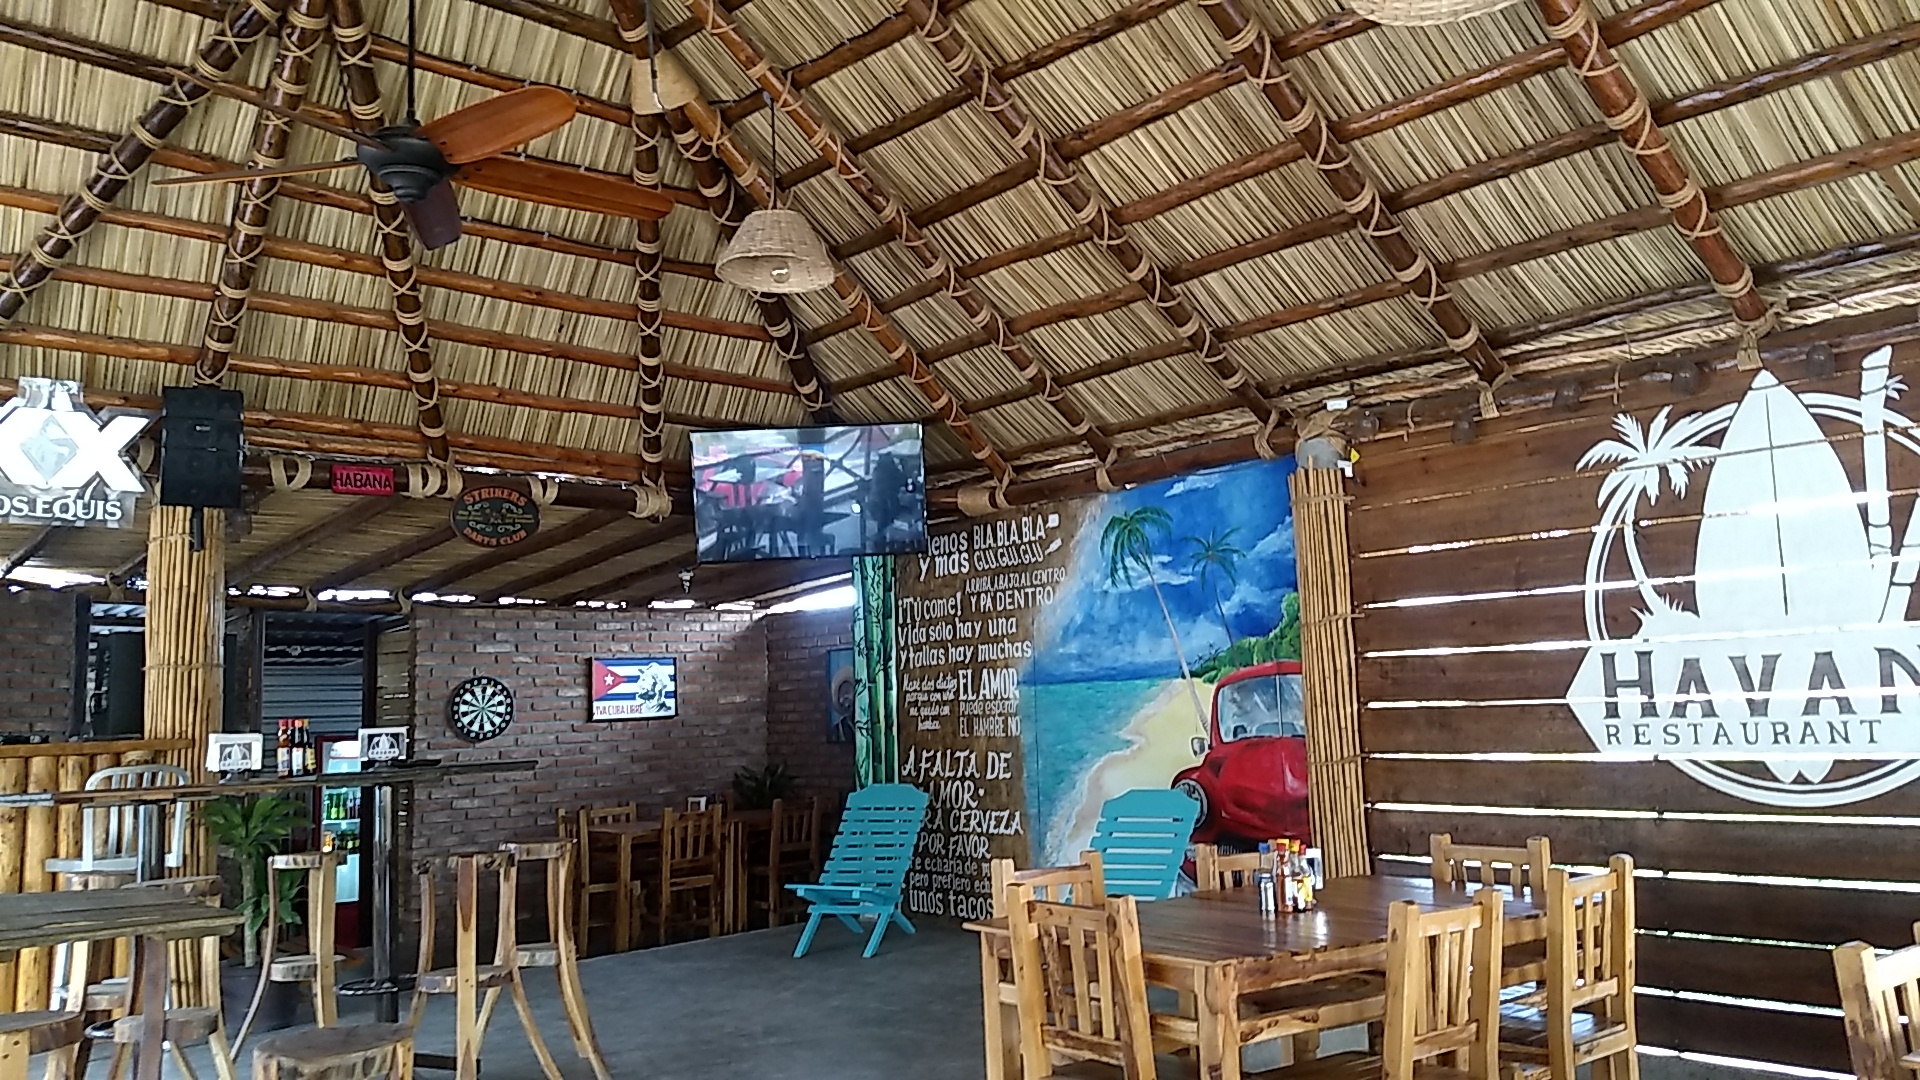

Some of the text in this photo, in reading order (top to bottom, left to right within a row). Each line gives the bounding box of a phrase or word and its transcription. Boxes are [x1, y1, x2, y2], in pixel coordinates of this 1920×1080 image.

[333, 472, 392, 490] HABANA
[463, 487, 527, 506] STRIKERS
[36, 497, 122, 520] EQUIS
[463, 527, 527, 546] DARTS CLUB
[1032, 567, 1066, 585] CENTRO
[970, 595, 978, 613] Y
[997, 586, 1054, 611] DENTRO
[955, 617, 982, 639] hay
[988, 617, 1017, 637] una
[899, 637, 1032, 670] y tallas hay muchas
[958, 668, 1020, 700] EL AMOR
[607, 704, 625, 716] CUBA
[626, 704, 643, 715] LIBRE
[960, 716, 1021, 737] EL HAMBRE NO
[1605, 719, 1881, 746] RESTAURANT
[901, 745, 1012, 783] A FALTA DE
[949, 809, 1024, 835] CERVEZA
[918, 831, 992, 859] POR FAVOR
[964, 857, 978, 876] de
[932, 873, 971, 892] prefiero
[909, 889, 994, 920] unos tacos
